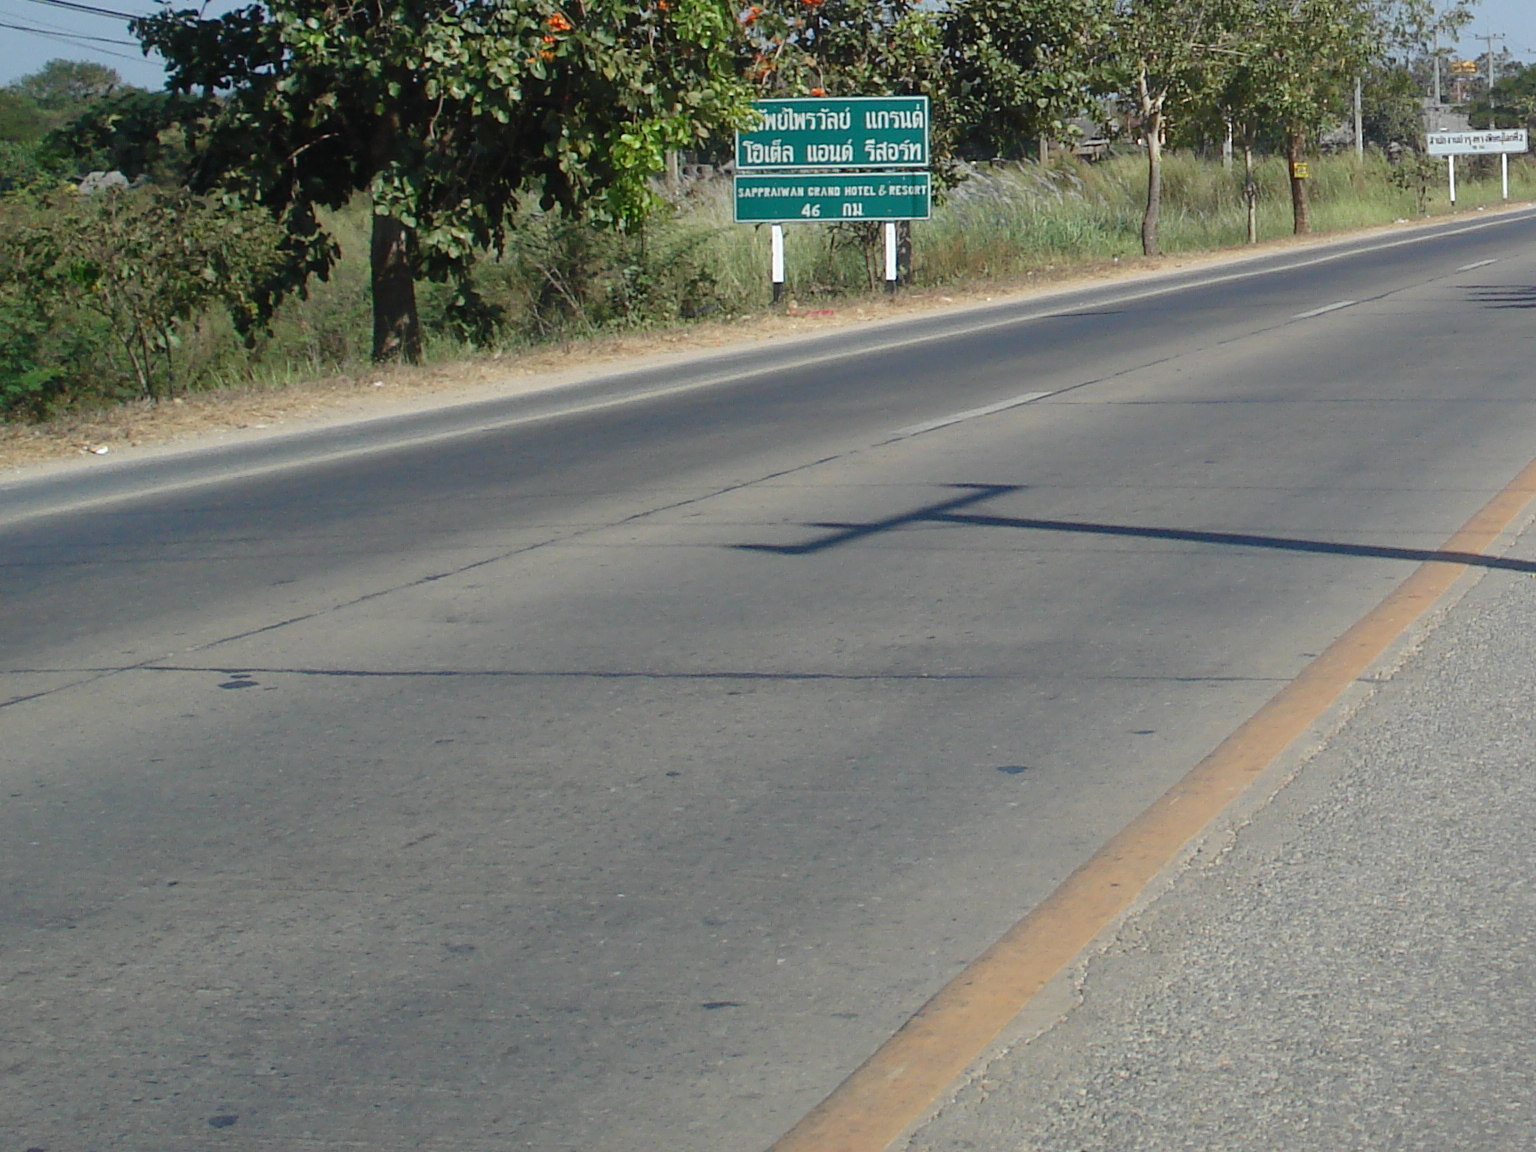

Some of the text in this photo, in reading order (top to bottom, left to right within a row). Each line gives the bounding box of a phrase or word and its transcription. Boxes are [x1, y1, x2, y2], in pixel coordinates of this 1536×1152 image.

[750, 107, 850, 131] ัพย์ไพรวัลย์
[742, 138, 922, 163] โฮเต็ล แอนด์ รีสอร์ท
[737, 184, 927, 198] SAPPRAIWAN GRAND HOTEL & RESORT
[801, 203, 821, 217] 46
